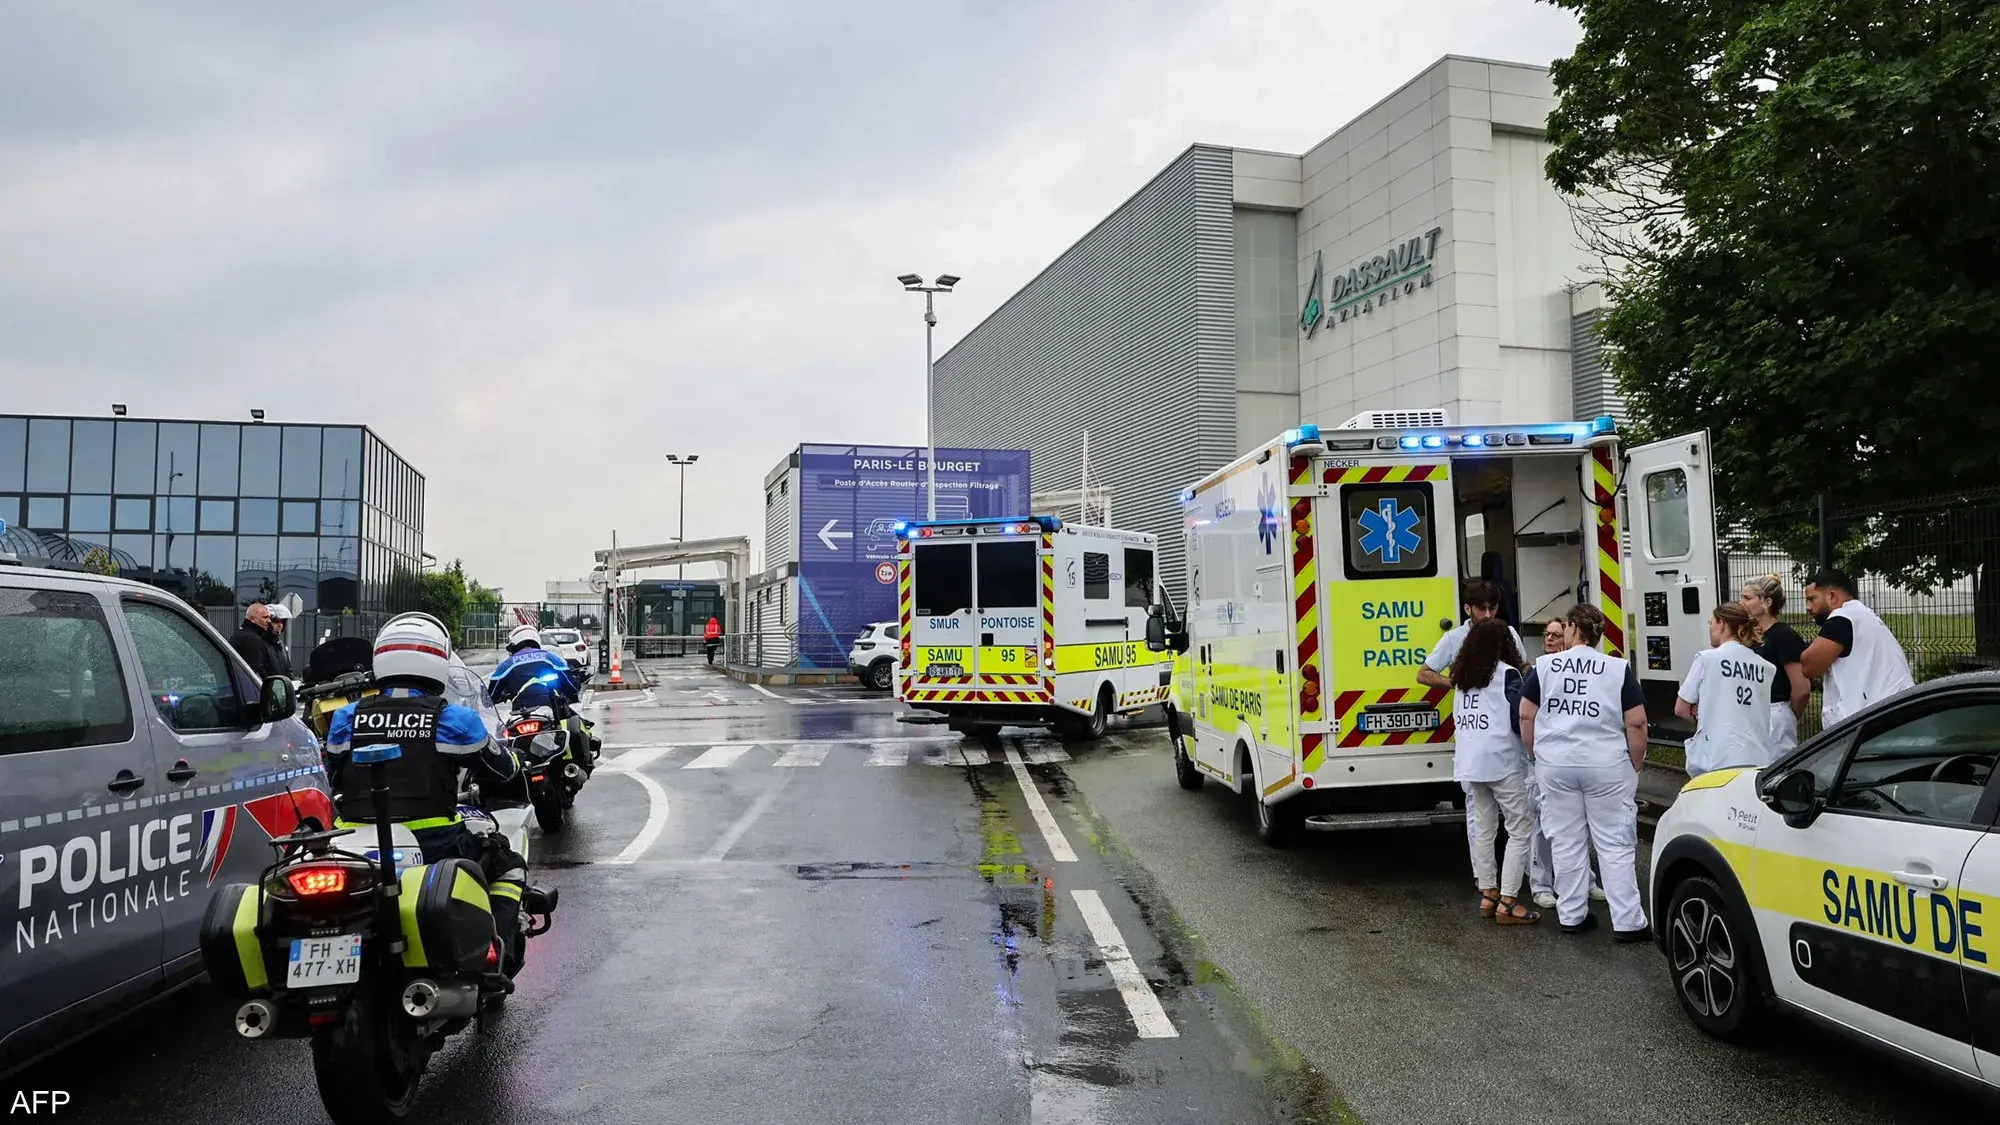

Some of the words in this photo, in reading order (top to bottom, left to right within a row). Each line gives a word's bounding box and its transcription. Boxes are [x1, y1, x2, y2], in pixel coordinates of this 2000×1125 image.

[1331, 227, 1442, 303] DASSAULT
[1326, 272, 1432, 330] AVIATION
[854, 459, 914, 470] PARIS-LE
[1323, 460, 1360, 468] NECKER
[834, 479, 856, 487] Poste
[858, 479, 888, 487] d'Accès
[890, 480, 918, 488] Routier
[920, 481, 968, 489] d'spection
[970, 482, 999, 490] Filtrage
[1068, 572, 1076, 586] 15
[1362, 601, 1424, 619] SAMU
[929, 618, 960, 629] SMUR
[981, 617, 1035, 628] PONTOISE
[1380, 625, 1409, 642] DE
[512, 652, 547, 663] POLICE
[928, 648, 963, 661] SAMU
[1001, 649, 1016, 662] 95
[1095, 645, 1124, 667] SAMU
[1126, 645, 1137, 664] 95
[1364, 648, 1427, 667] PARIS
[1551, 657, 1606, 675] SAMU
[1720, 659, 1765, 683] SAMU
[1563, 678, 1588, 695] DE
[1211, 684, 1229, 708] SAMU
[1229, 688, 1240, 711] DE
[1240, 690, 1262, 717] PARIS
[1463, 694, 1479, 709] DE
[1736, 686, 1752, 705] 92
[1547, 698, 1600, 717] PARIS
[354, 713, 434, 729] POLICE
[387, 729, 416, 738] MOTO
[419, 729, 431, 738] 93
[1738, 810, 1758, 824] Petit
[18, 813, 193, 910] POLICE
[15, 869, 191, 954] NATIONALE
[1822, 869, 1918, 945] SAMU
[1930, 893, 1988, 964] DE
